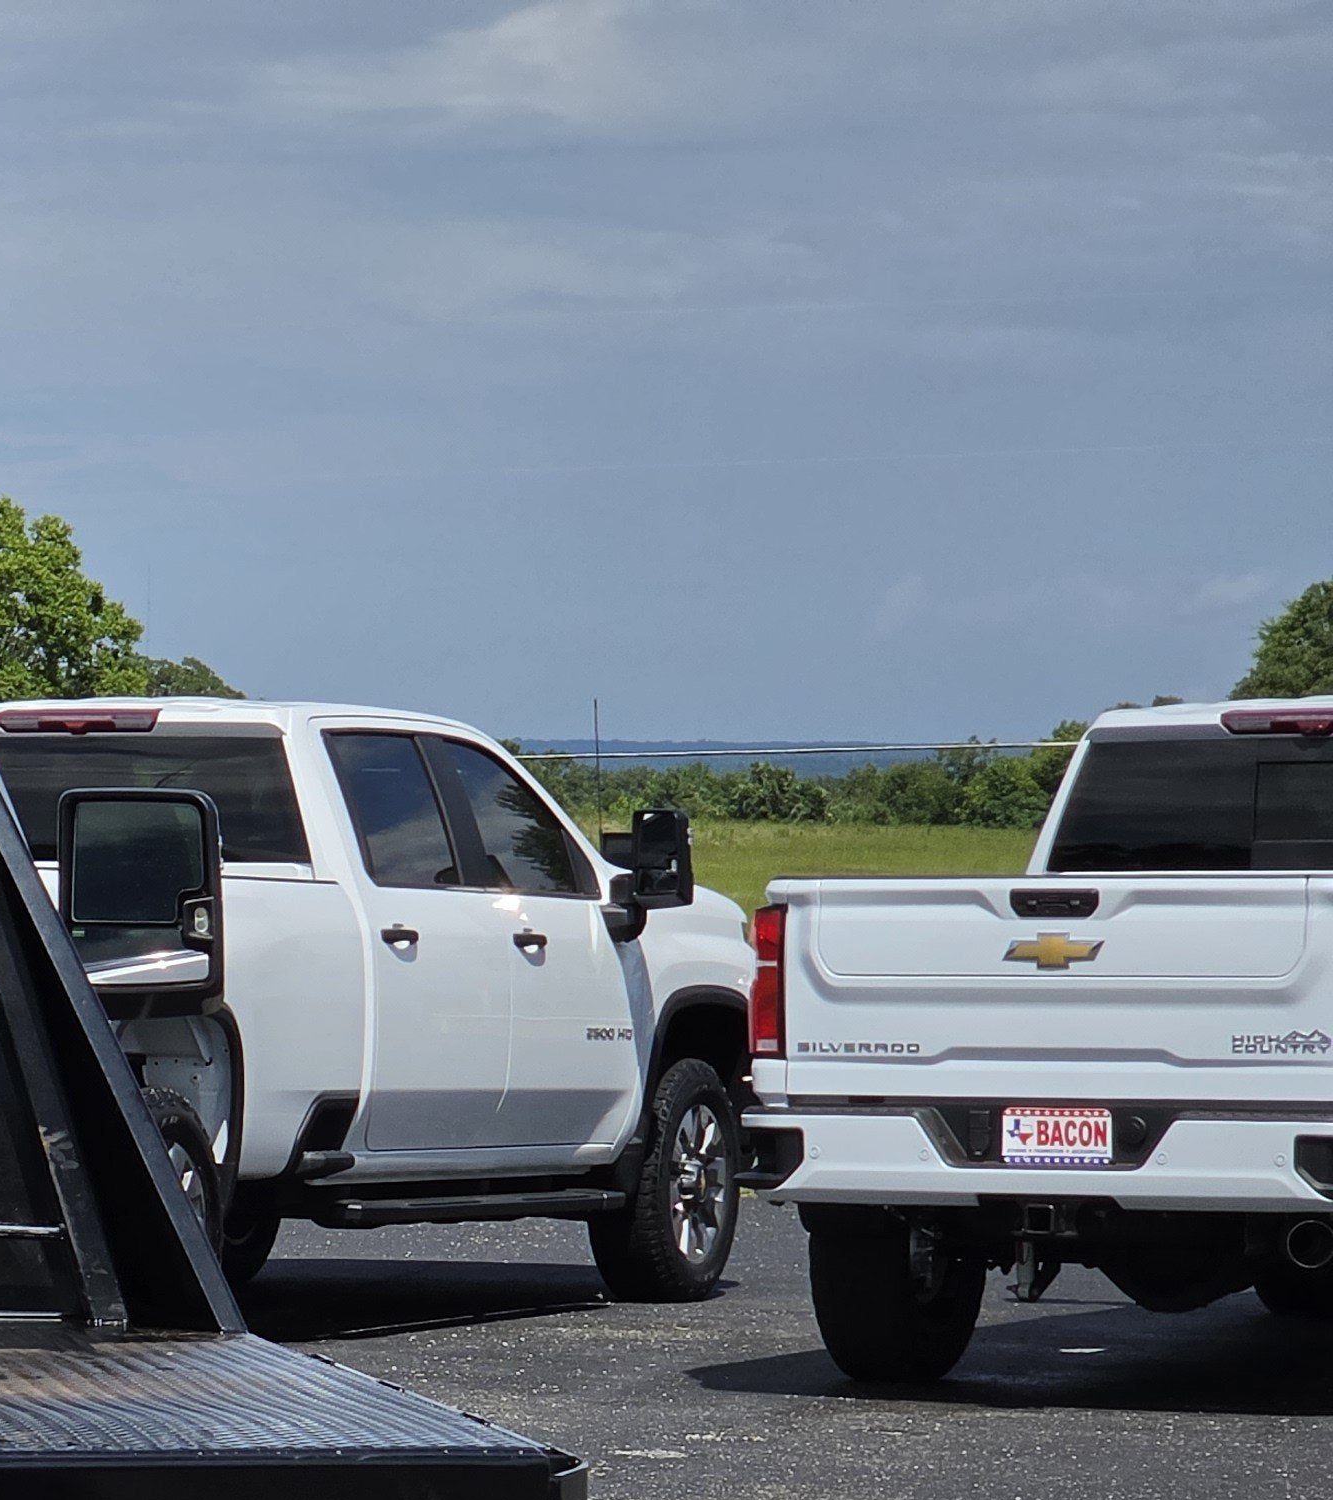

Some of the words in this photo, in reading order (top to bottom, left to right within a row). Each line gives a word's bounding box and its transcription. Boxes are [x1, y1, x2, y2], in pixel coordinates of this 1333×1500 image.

[1231, 1035, 1280, 1044] HIGH
[797, 1042, 921, 1054] SILVERADO
[1231, 1044, 1331, 1054] COUNTRY
[1036, 1120, 1107, 1147] BACON
